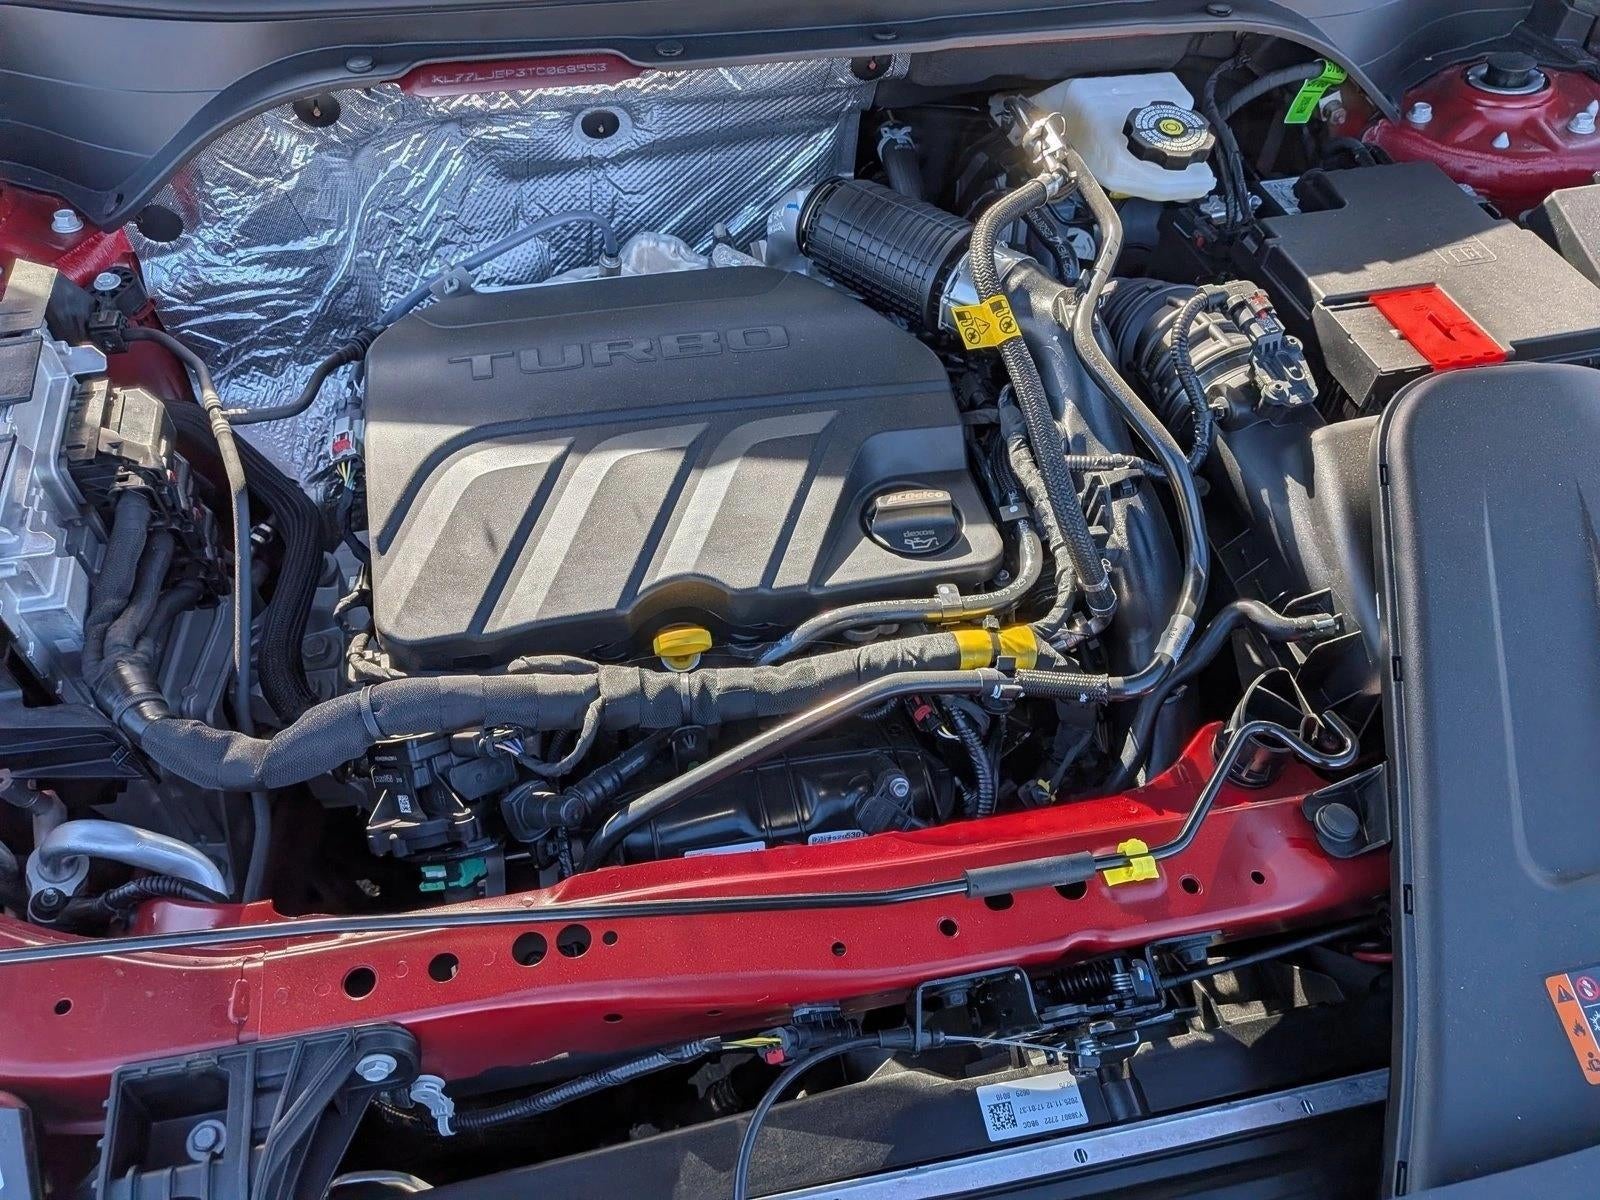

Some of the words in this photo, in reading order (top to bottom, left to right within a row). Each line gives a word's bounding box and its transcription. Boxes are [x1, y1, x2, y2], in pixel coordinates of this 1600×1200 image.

[432, 62, 608, 84] KL77LJEP3TC068553
[447, 325, 790, 380] TURBO
[886, 491, 944, 505] ACDelco
[1044, 1115, 1058, 1125] 2722
